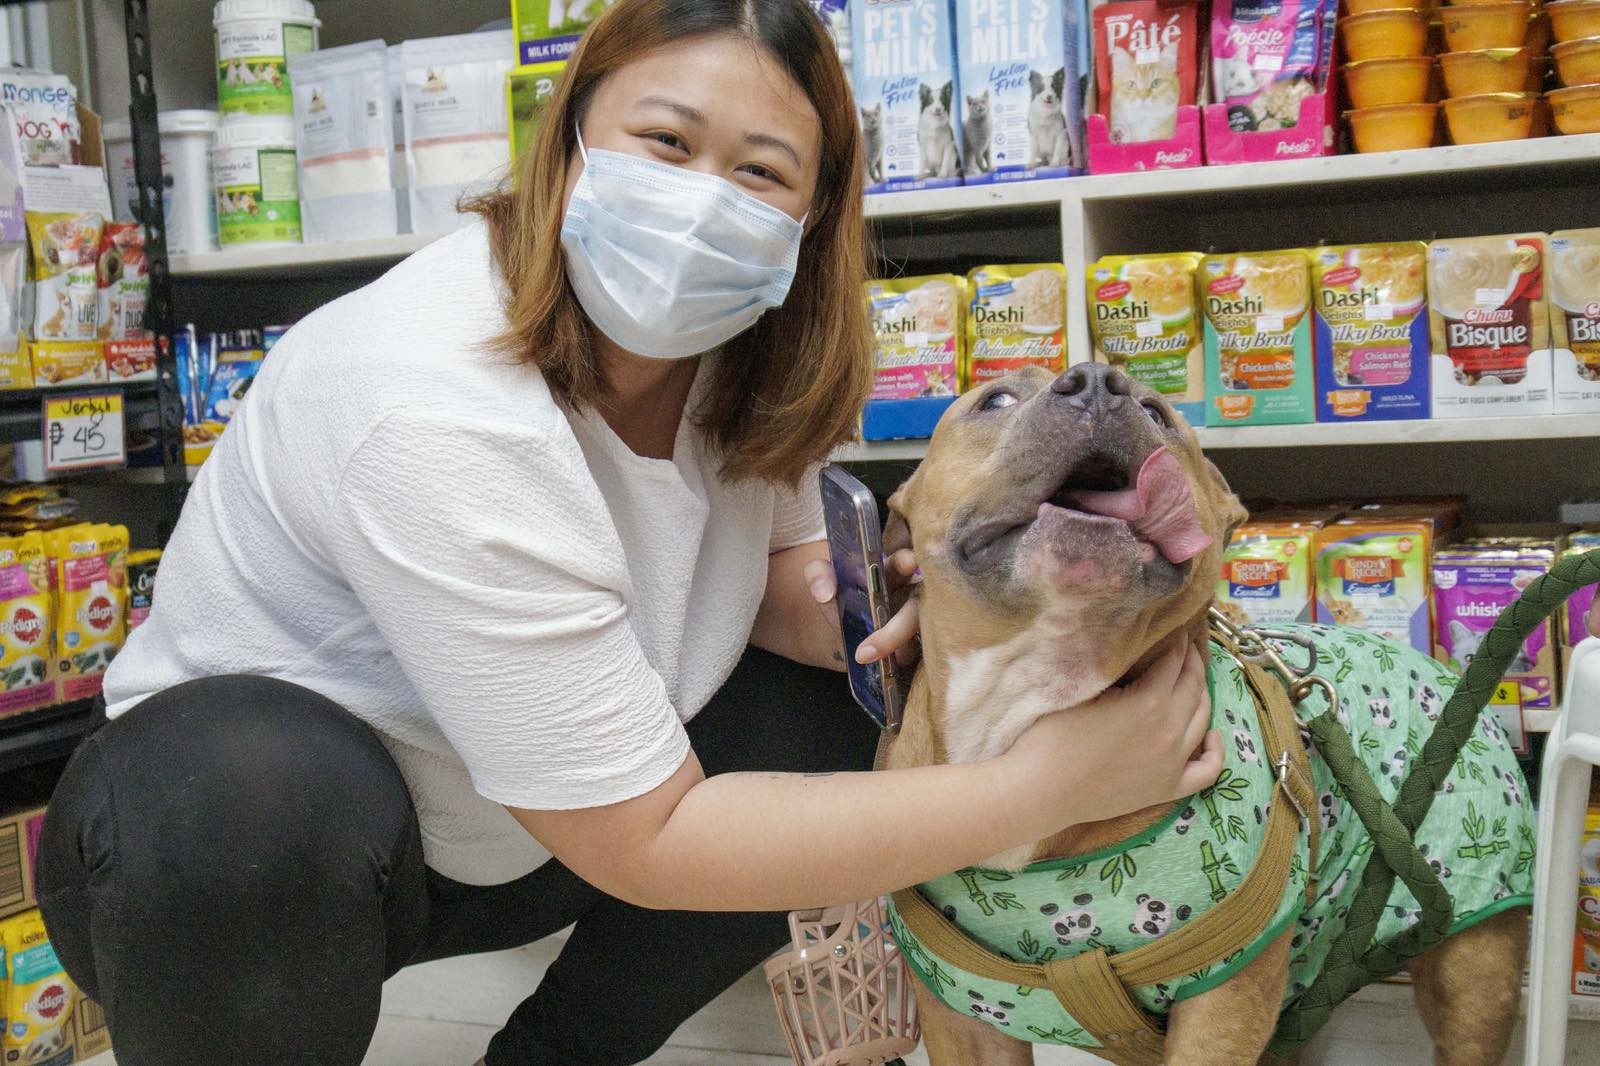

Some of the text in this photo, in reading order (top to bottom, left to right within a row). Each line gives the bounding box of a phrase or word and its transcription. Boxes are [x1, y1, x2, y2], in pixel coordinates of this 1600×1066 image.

[864, 2, 937, 41] PET'S
[970, 0, 1048, 26] PETS
[971, 21, 1048, 64] MILK
[1104, 13, 1182, 56] Pâté
[1225, 24, 1284, 48] Poésie
[528, 45, 550, 58] MILK
[864, 35, 938, 77] MILK
[994, 76, 1025, 96] Free
[887, 89, 914, 109] Free
[1209, 296, 1263, 316] Dashi
[1322, 287, 1379, 308] Dashi
[975, 305, 1025, 323] Dashi
[1096, 301, 1149, 322] Dashi
[1463, 306, 1514, 323] Churu
[976, 325, 1010, 339] Delights
[1450, 324, 1528, 350] Bisque
[1019, 338, 1063, 357] Flakes
[1103, 331, 1188, 355] Silky Broth
[1364, 351, 1399, 360] Chicken
[1359, 361, 1392, 371] Salmon
[73, 426, 106, 453] 45
[1240, 569, 1270, 580] RECIPE
[1353, 568, 1386, 579] RECIPE
